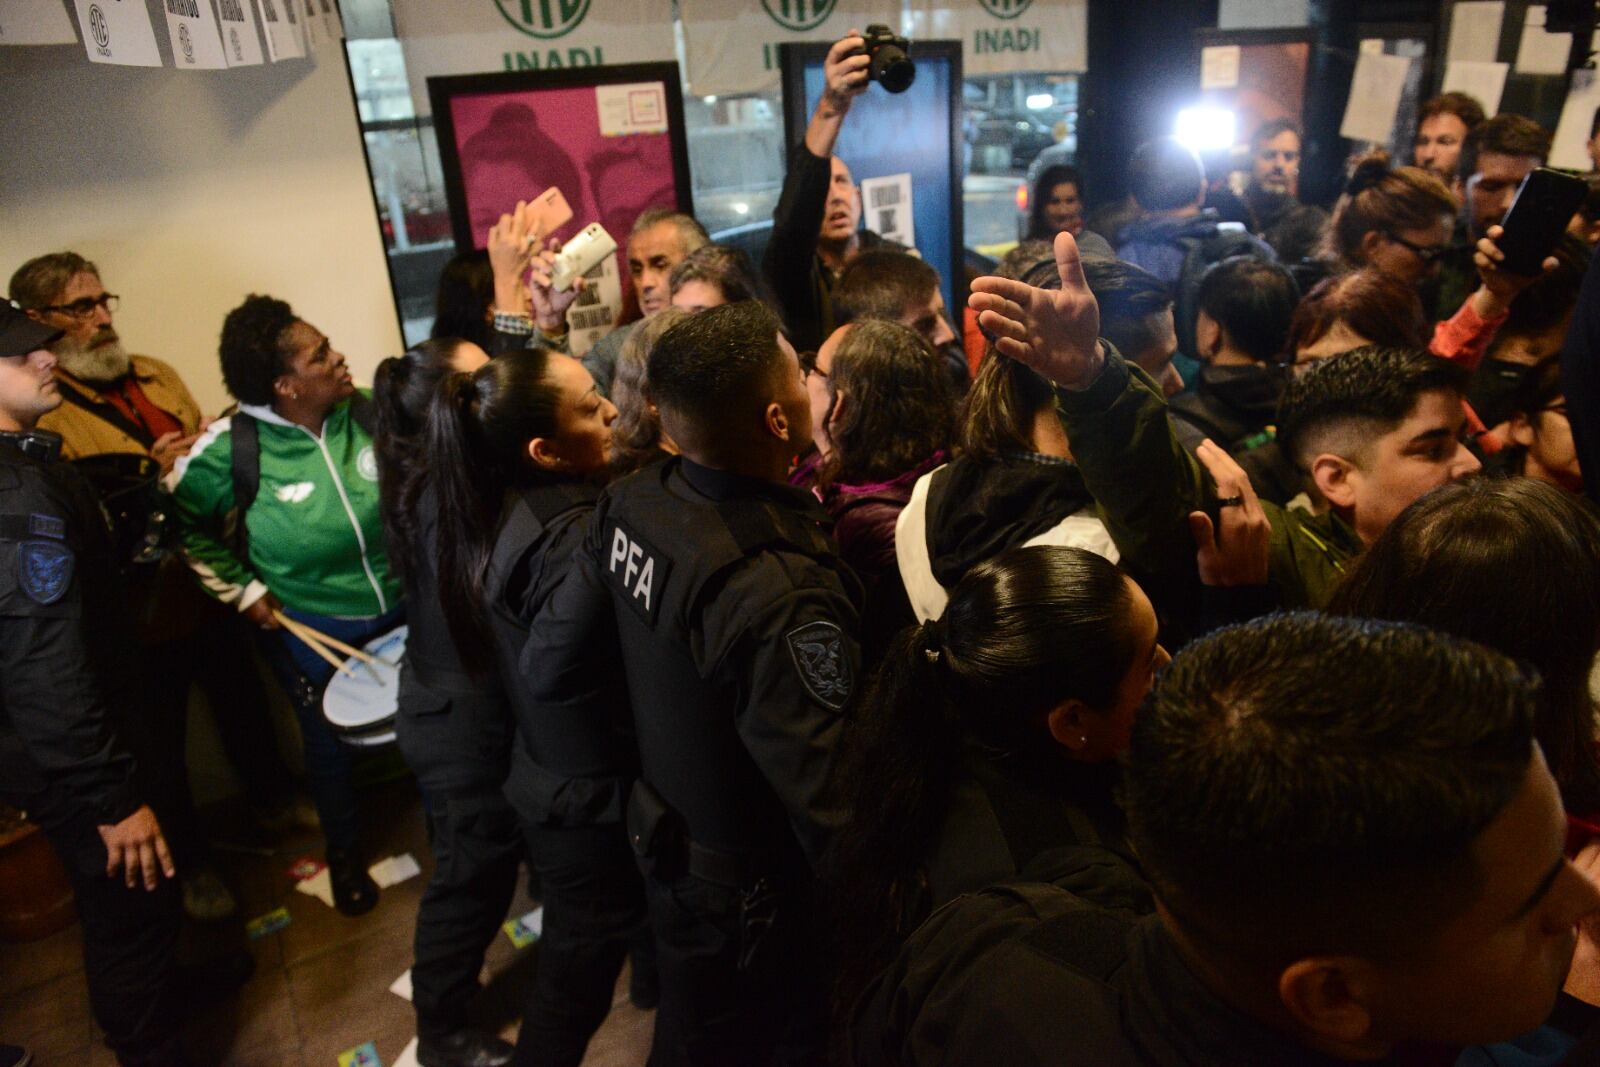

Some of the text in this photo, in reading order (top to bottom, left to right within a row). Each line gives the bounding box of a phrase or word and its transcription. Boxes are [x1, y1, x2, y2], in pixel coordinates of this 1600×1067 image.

[974, 27, 1040, 54] INADI
[503, 46, 603, 73] INADI
[609, 526, 654, 611] PFA
